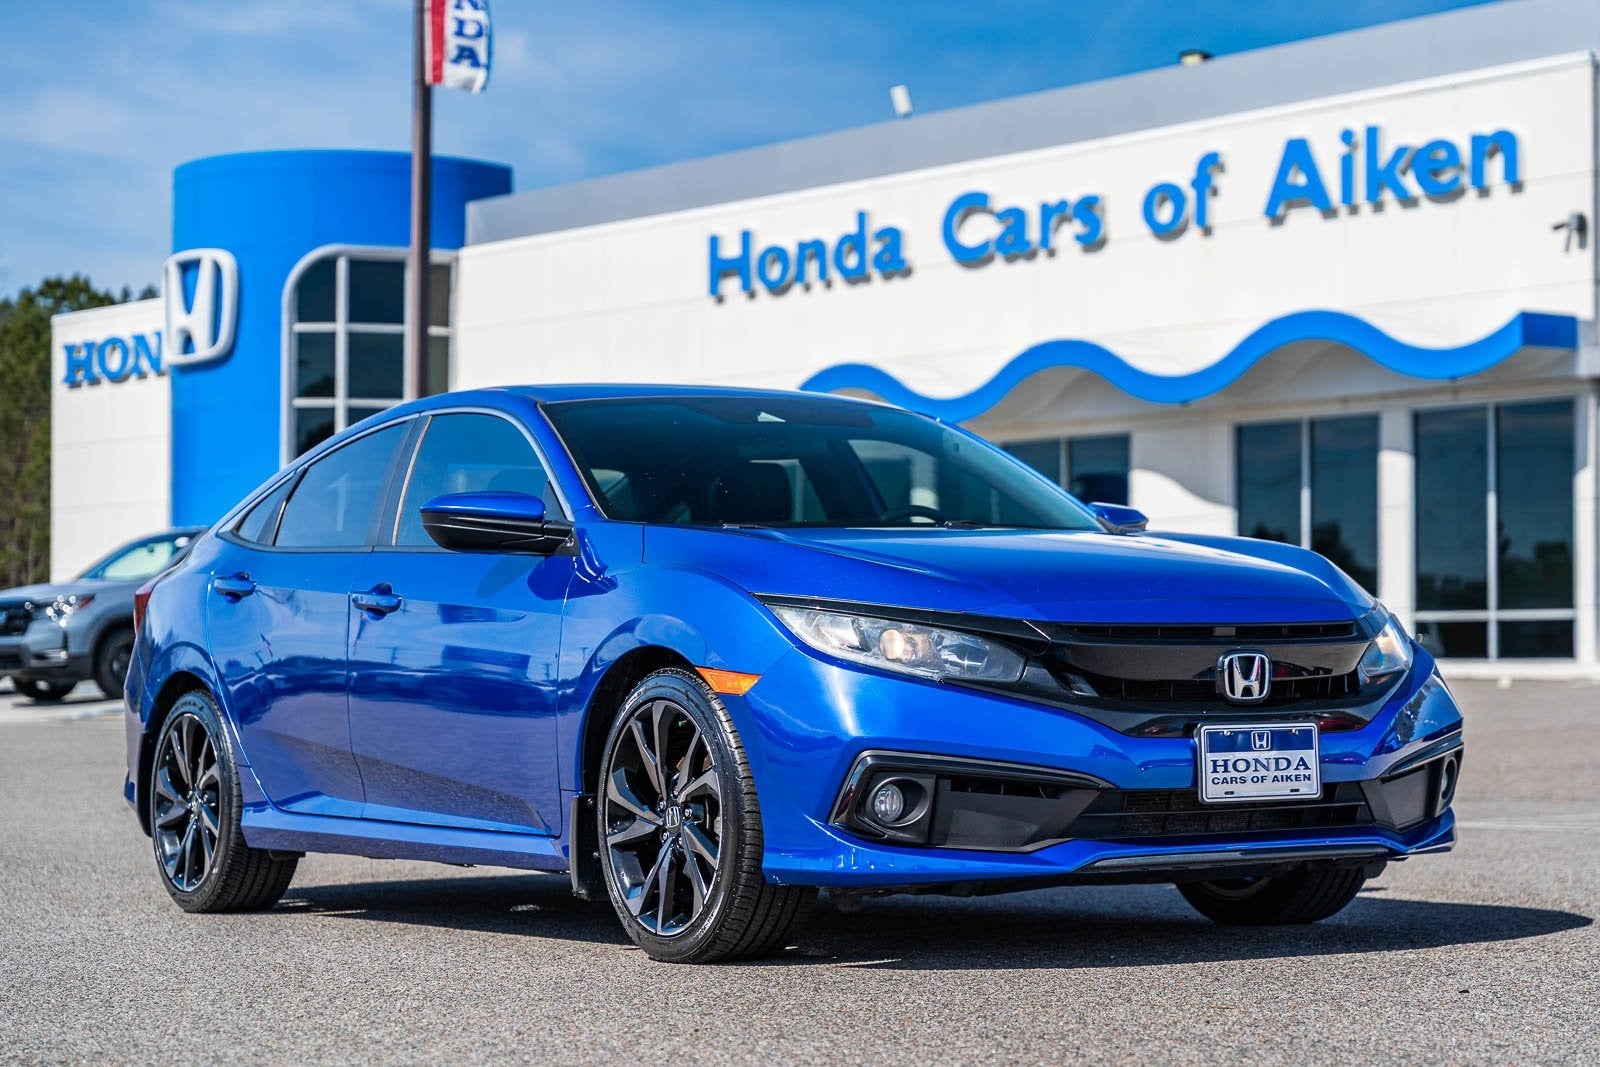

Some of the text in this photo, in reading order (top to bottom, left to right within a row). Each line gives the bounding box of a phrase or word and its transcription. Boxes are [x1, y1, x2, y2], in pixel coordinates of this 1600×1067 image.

[708, 125, 1519, 298] Honda Cars of Aiken
[1210, 756, 1312, 774] HONDA
[1211, 773, 1311, 785] CARS OF AIKEN
